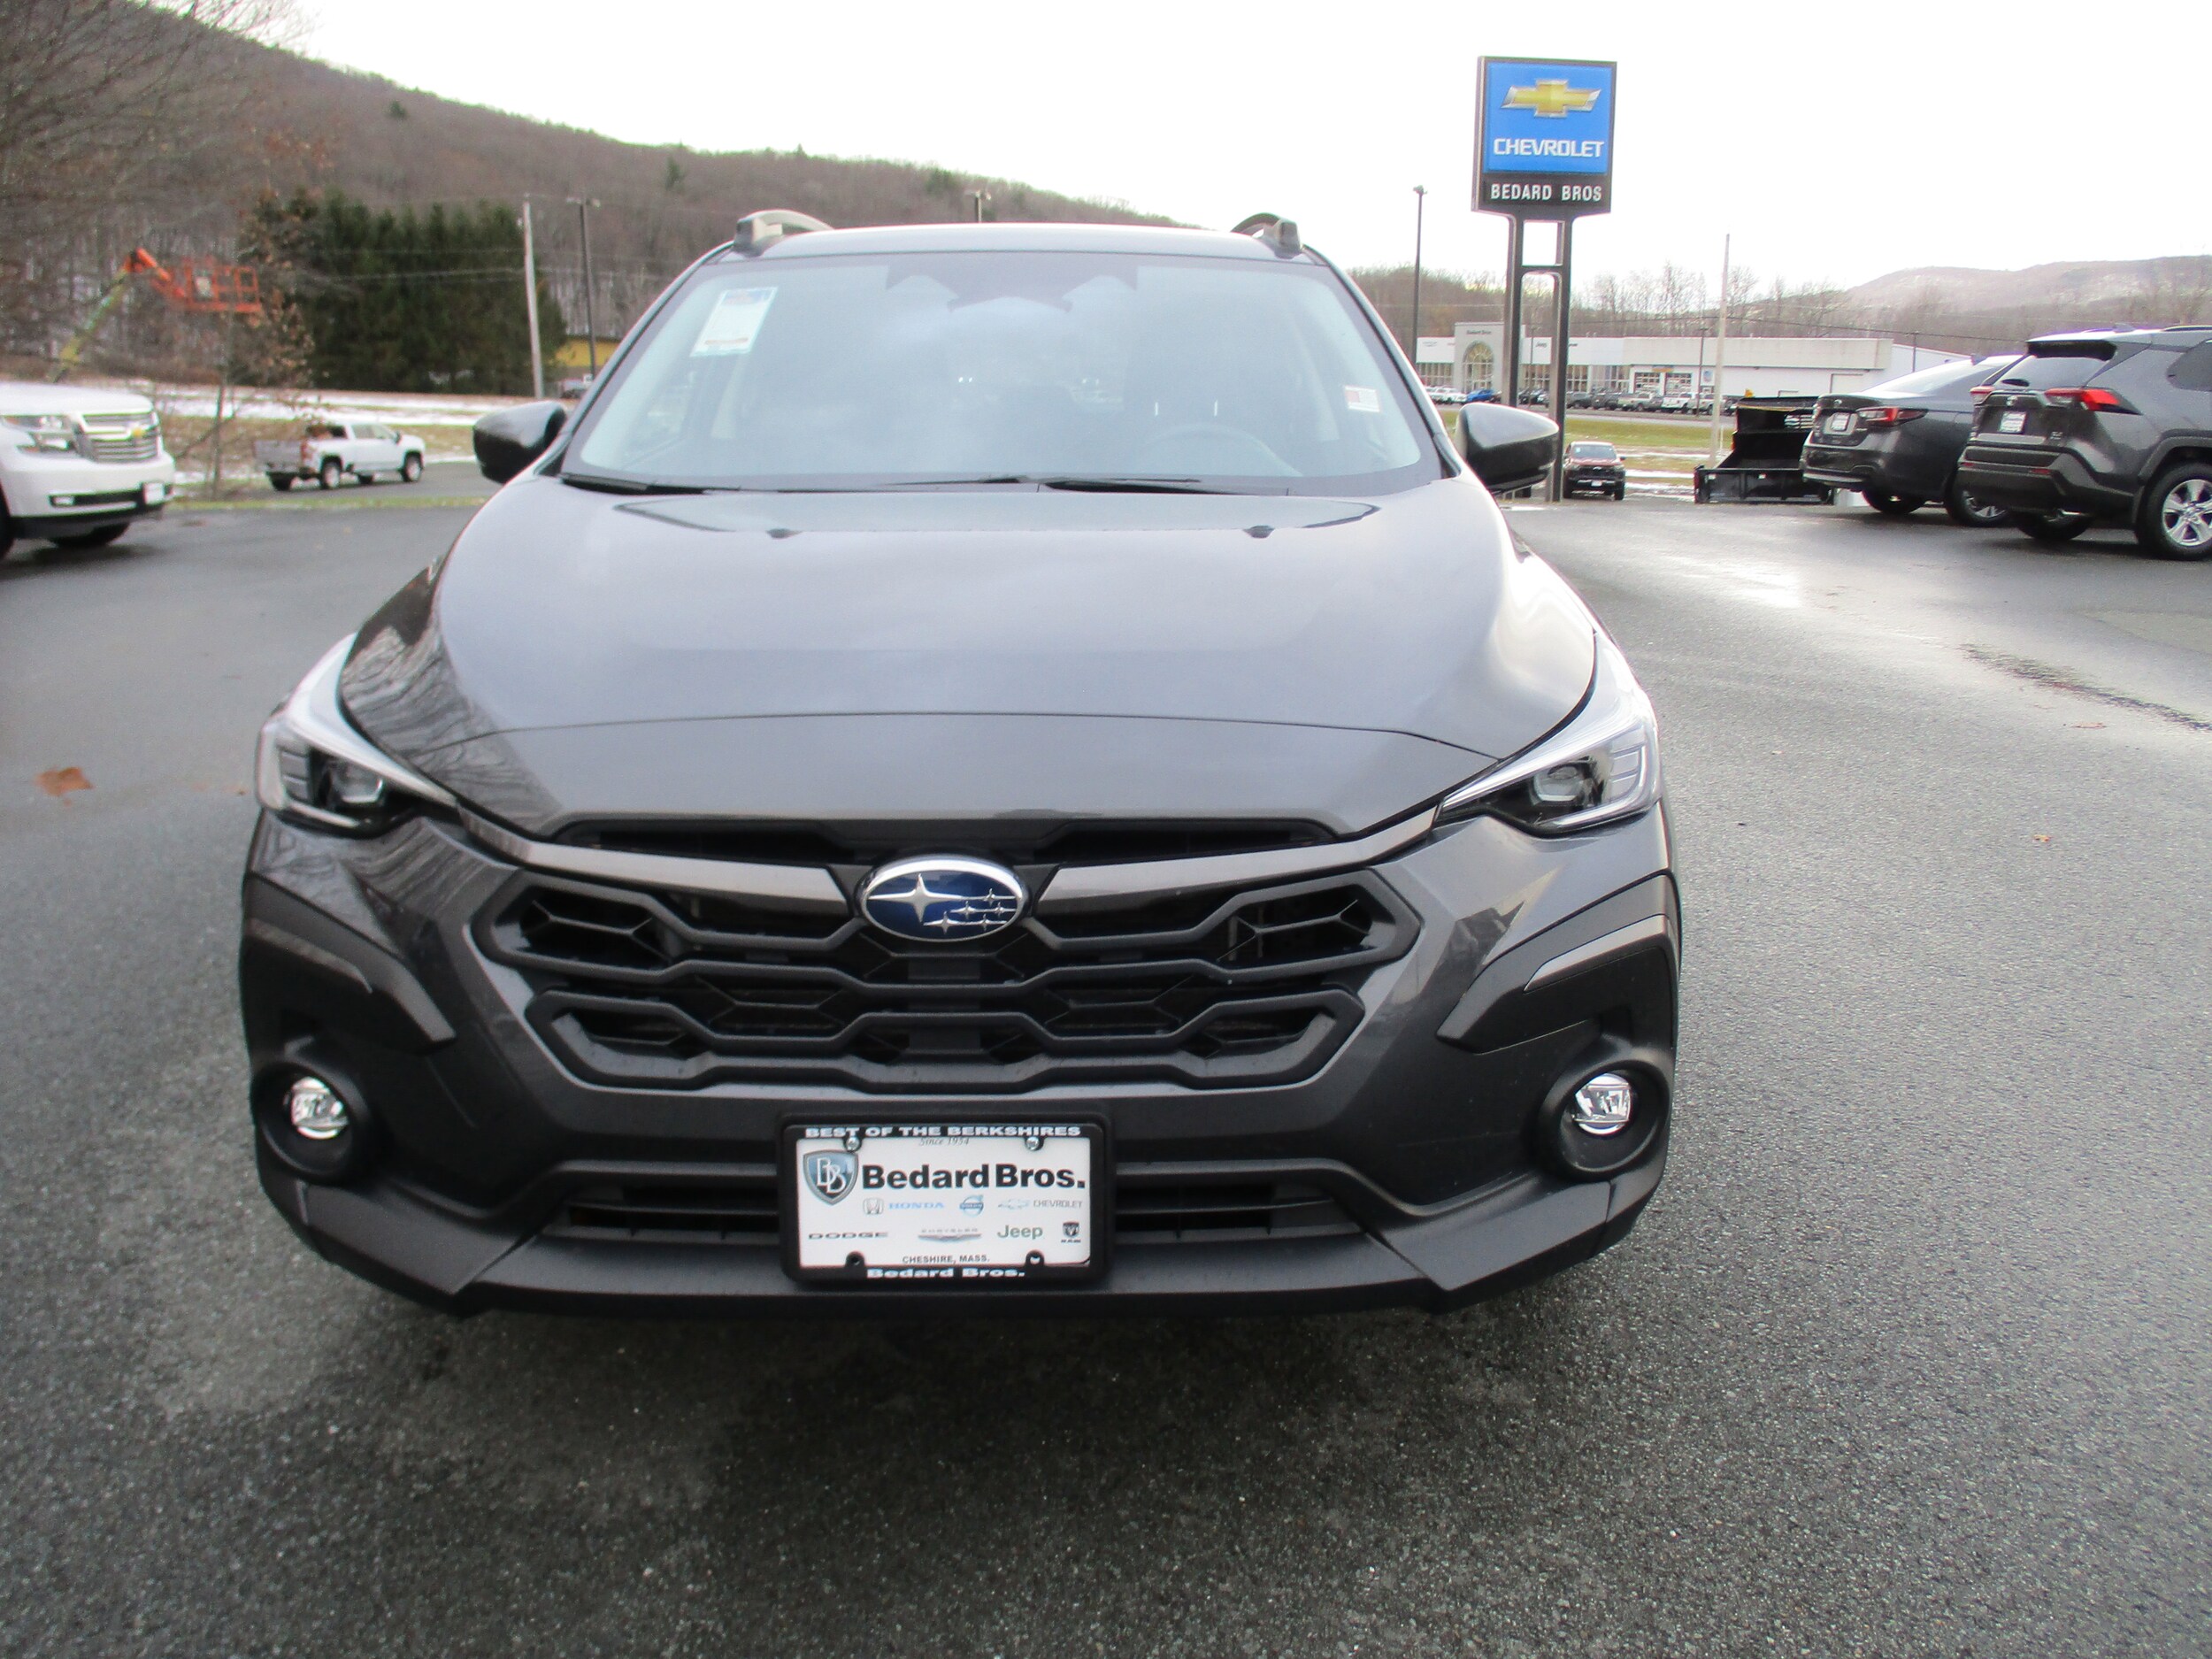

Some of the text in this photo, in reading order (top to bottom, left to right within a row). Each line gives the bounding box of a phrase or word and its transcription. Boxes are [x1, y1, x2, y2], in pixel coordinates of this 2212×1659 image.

[1493, 138, 1605, 157] CHEVROLET
[1490, 183, 1602, 202] BEDARD BROS
[805, 1125, 1081, 1138] BEST OF THE BERKSHIRES
[918, 1137, 944, 1146] Since
[862, 1164, 1087, 1190] Bedard Bros.
[1033, 1199, 1082, 1209] CHEVROLET
[997, 1225, 1043, 1240] Jeep
[902, 1255, 990, 1264] CHESHIRE, MASS.
[867, 1267, 1025, 1278] Bedard Bros.
